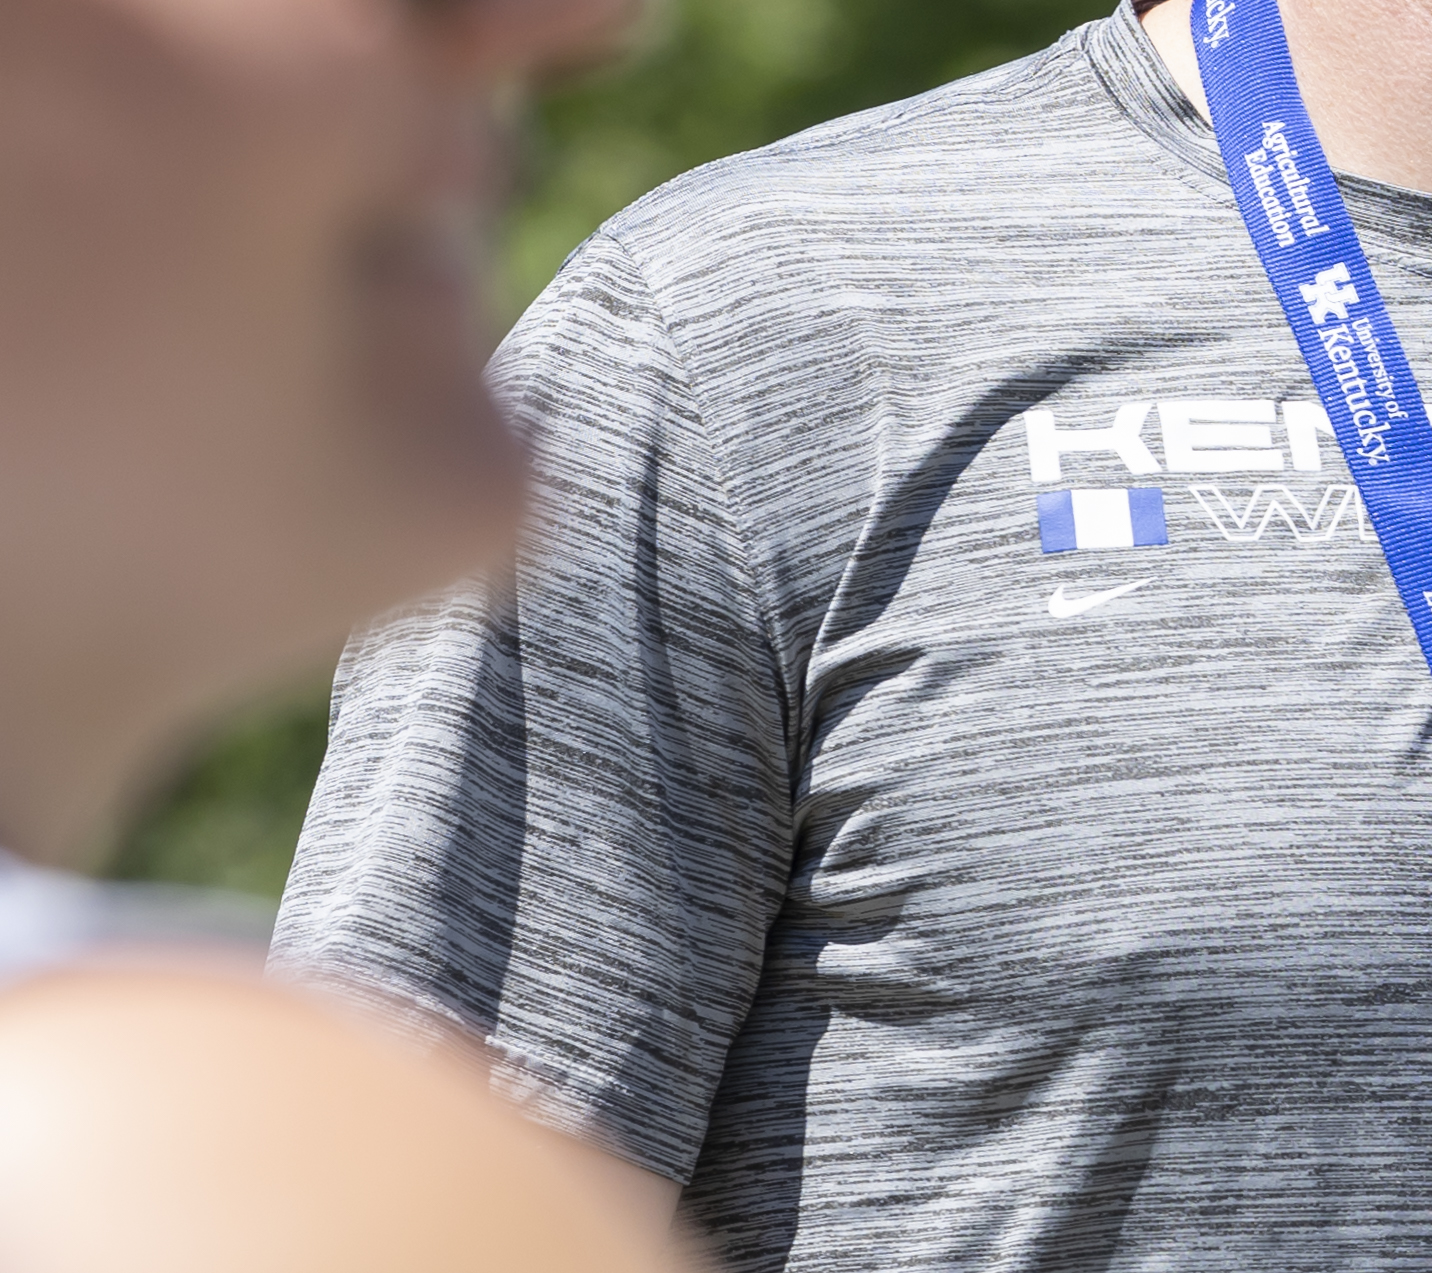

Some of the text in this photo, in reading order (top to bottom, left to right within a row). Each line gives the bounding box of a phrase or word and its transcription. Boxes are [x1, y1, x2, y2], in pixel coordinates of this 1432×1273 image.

[1244, 150, 1296, 248] Education
[1261, 119, 1329, 239] Agricultural
[1351, 316, 1408, 420] University of
